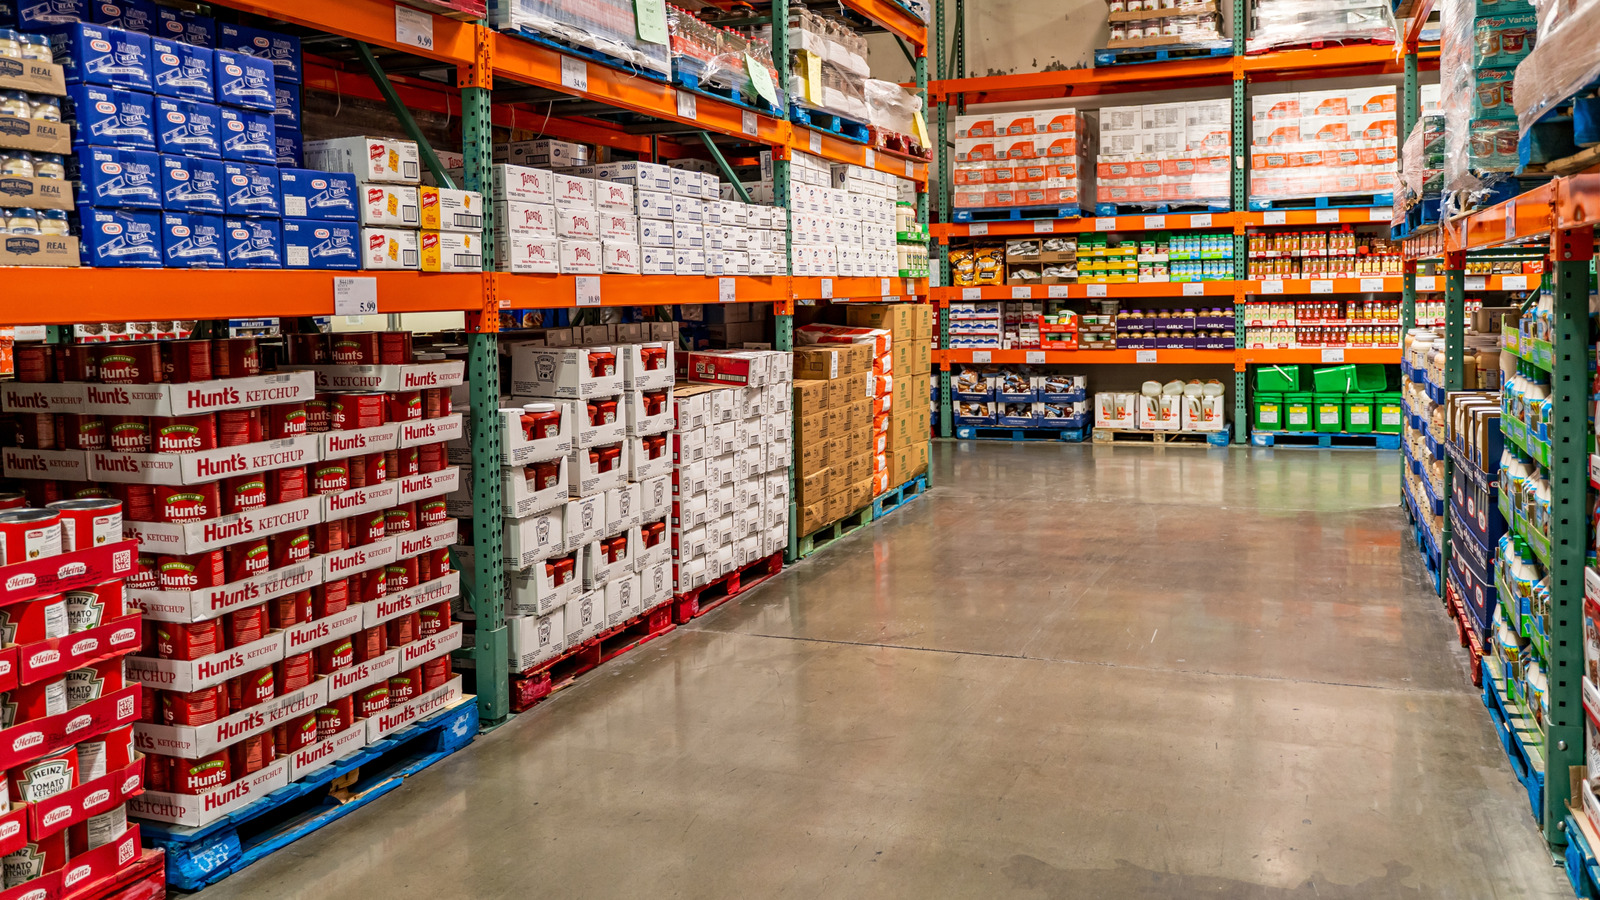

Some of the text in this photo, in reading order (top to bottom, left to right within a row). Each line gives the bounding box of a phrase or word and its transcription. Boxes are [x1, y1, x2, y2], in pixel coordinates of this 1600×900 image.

[417, 35, 432, 47] 9.99
[31, 66, 52, 77] REAL
[37, 126, 58, 136] REAL
[41, 184, 61, 194] REAL
[46, 242, 67, 251] REAL
[360, 302, 376, 312] 5.99
[333, 376, 382, 388] KETCHUP
[405, 371, 460, 387] Hunt's KETCHUP
[7, 392, 82, 409] Hunt's KETCHUP
[87, 387, 163, 405] Hunt's KETCHUP
[188, 386, 300, 408] Hunt's KETCHUP
[164, 425, 196, 433] PREMIUM
[404, 423, 458, 440] Hunt's KETCHUP
[160, 435, 201, 449] Hunt's
[329, 433, 393, 452] Hunt's KETCHUP
[7, 453, 79, 472] Hunt's KETCHUP
[95, 454, 173, 473] Hunt's KETCHUP
[197, 450, 304, 477] Hunt's KETCHUP
[314, 477, 347, 489] Hunt's
[402, 474, 455, 494] Hunt's KETCHUP
[169, 495, 201, 503] PREMIUM
[330, 489, 393, 511] Hunt's KETCHUP
[165, 504, 207, 518] Hunt's
[204, 509, 309, 542] Hunt's KETCHUP
[147, 533, 179, 543] KETCHUP
[401, 532, 454, 555] Hunt's KETCHUP
[330, 546, 392, 572] Hunt's KETCHUP
[59, 564, 86, 578] Heinz
[8, 575, 36, 588] Heinz
[211, 570, 313, 610] Hunt's KETCHUP
[67, 598, 89, 606] EINZ
[151, 604, 185, 613] KETCHUP
[377, 584, 452, 618] Hunt's KETCHUP
[111, 630, 136, 643] Heinz
[290, 614, 358, 648] Hunt's KETCHUP
[72, 640, 98, 654] Heinz
[406, 631, 458, 660] Hunt's KETCHUP
[31, 652, 60, 666] Heinz
[198, 643, 277, 680] Hunt's KETCHUP
[126, 669, 175, 684] ETCHUP
[333, 656, 395, 689] Hunt's KETCHUP
[217, 692, 319, 742] Hunt's KETCHUP
[379, 688, 455, 733] Hunt's KETCHUP
[14, 733, 43, 749] Heinz
[157, 738, 190, 750] KETCHUP
[296, 729, 361, 768] Hunt's KETCHUP
[33, 765, 62, 780] HEINZ
[187, 771, 227, 788] Hunt's
[31, 777, 65, 791] TOMATO
[204, 766, 282, 811] Hunt's KETCHUP
[33, 786, 64, 799] KETCHUP
[84, 790, 109, 808] Heinz
[45, 808, 72, 826] Heinz
[66, 867, 91, 885] Heinz
